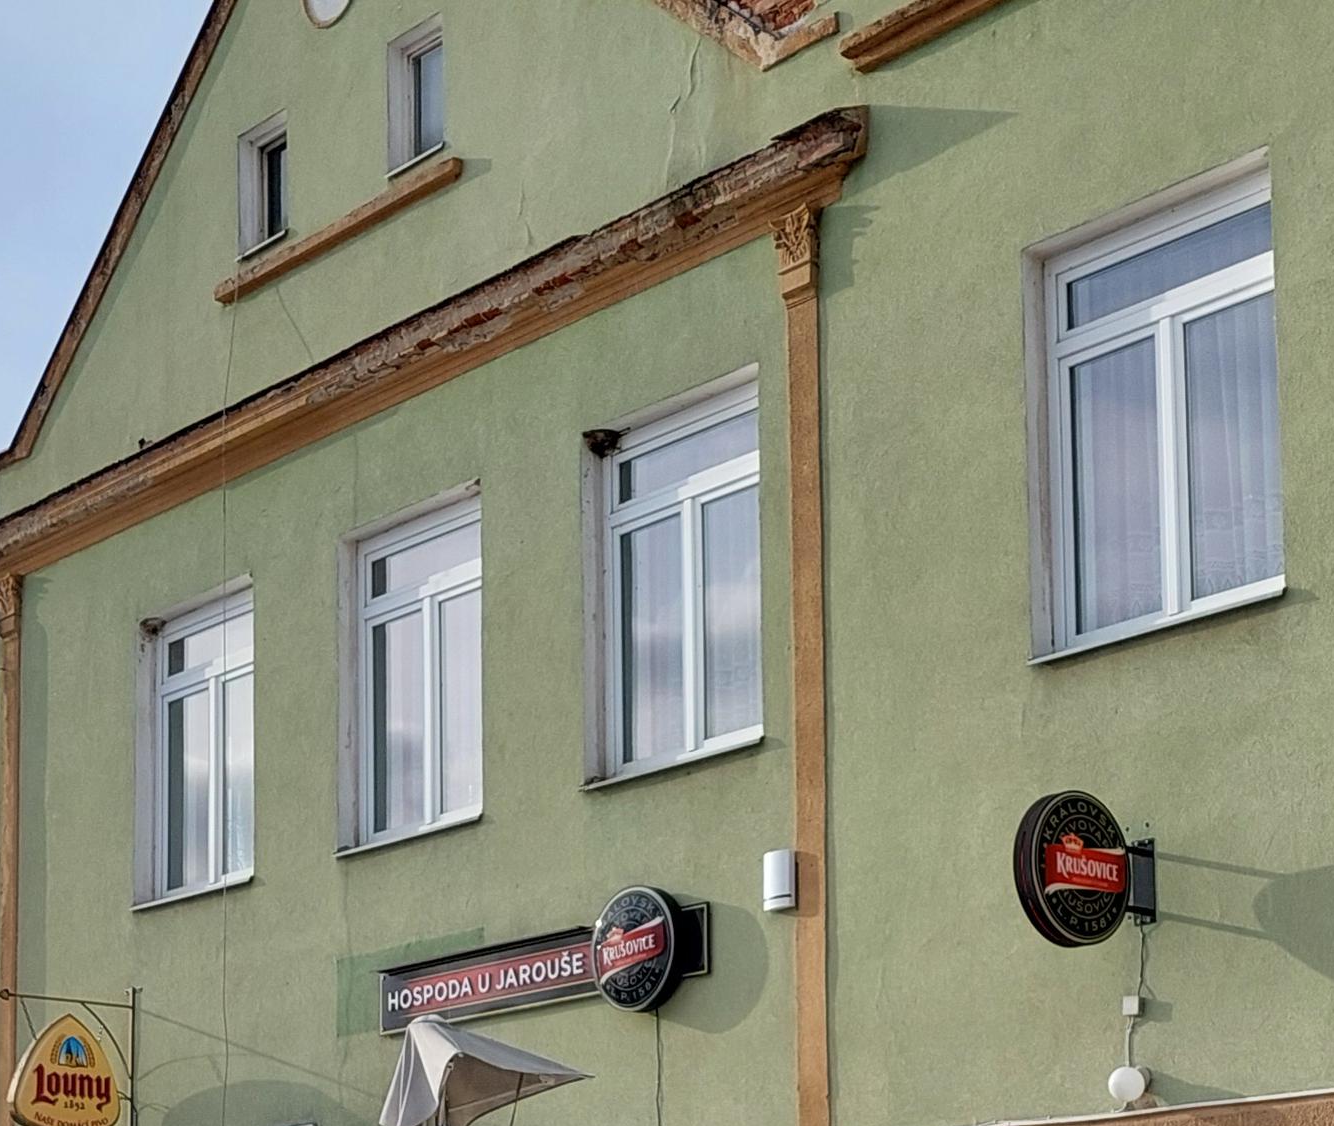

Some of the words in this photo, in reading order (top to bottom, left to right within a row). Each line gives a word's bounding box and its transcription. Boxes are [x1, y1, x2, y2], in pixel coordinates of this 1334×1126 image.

[1063, 819, 1110, 848] IVOVAR
[1056, 851, 1119, 882] KRUŠOVICE
[602, 934, 656, 966] KRUŠOVICE
[387, 976, 473, 1012] HOSPODA
[477, 972, 490, 993] U
[495, 951, 584, 990] JAROUŠE
[31, 1063, 111, 1113] Louny
